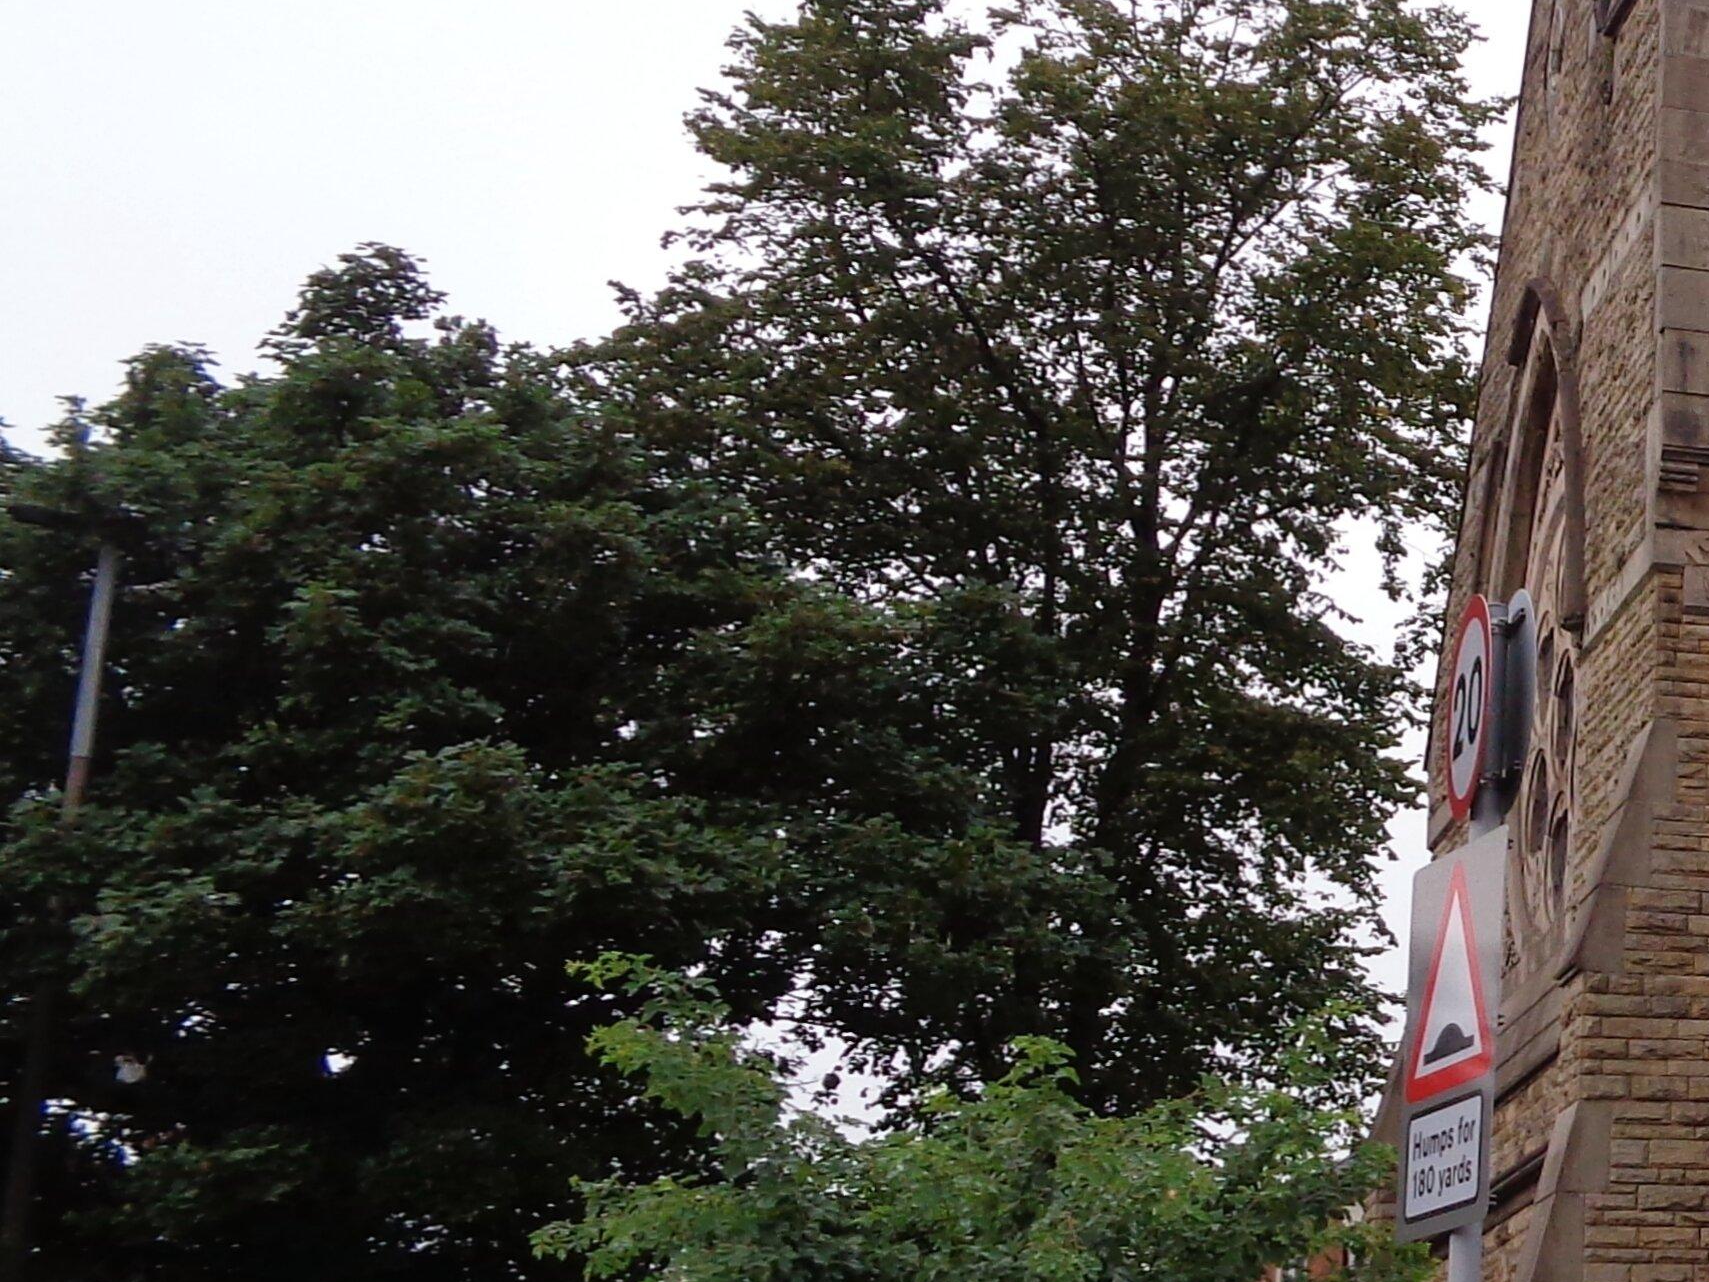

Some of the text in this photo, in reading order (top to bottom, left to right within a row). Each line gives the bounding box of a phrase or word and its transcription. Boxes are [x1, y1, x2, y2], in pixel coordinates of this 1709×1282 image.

[1453, 655, 1482, 761] 20
[1413, 1116, 1476, 1161] Humps for
[1413, 1154, 1472, 1199] 180 yards
